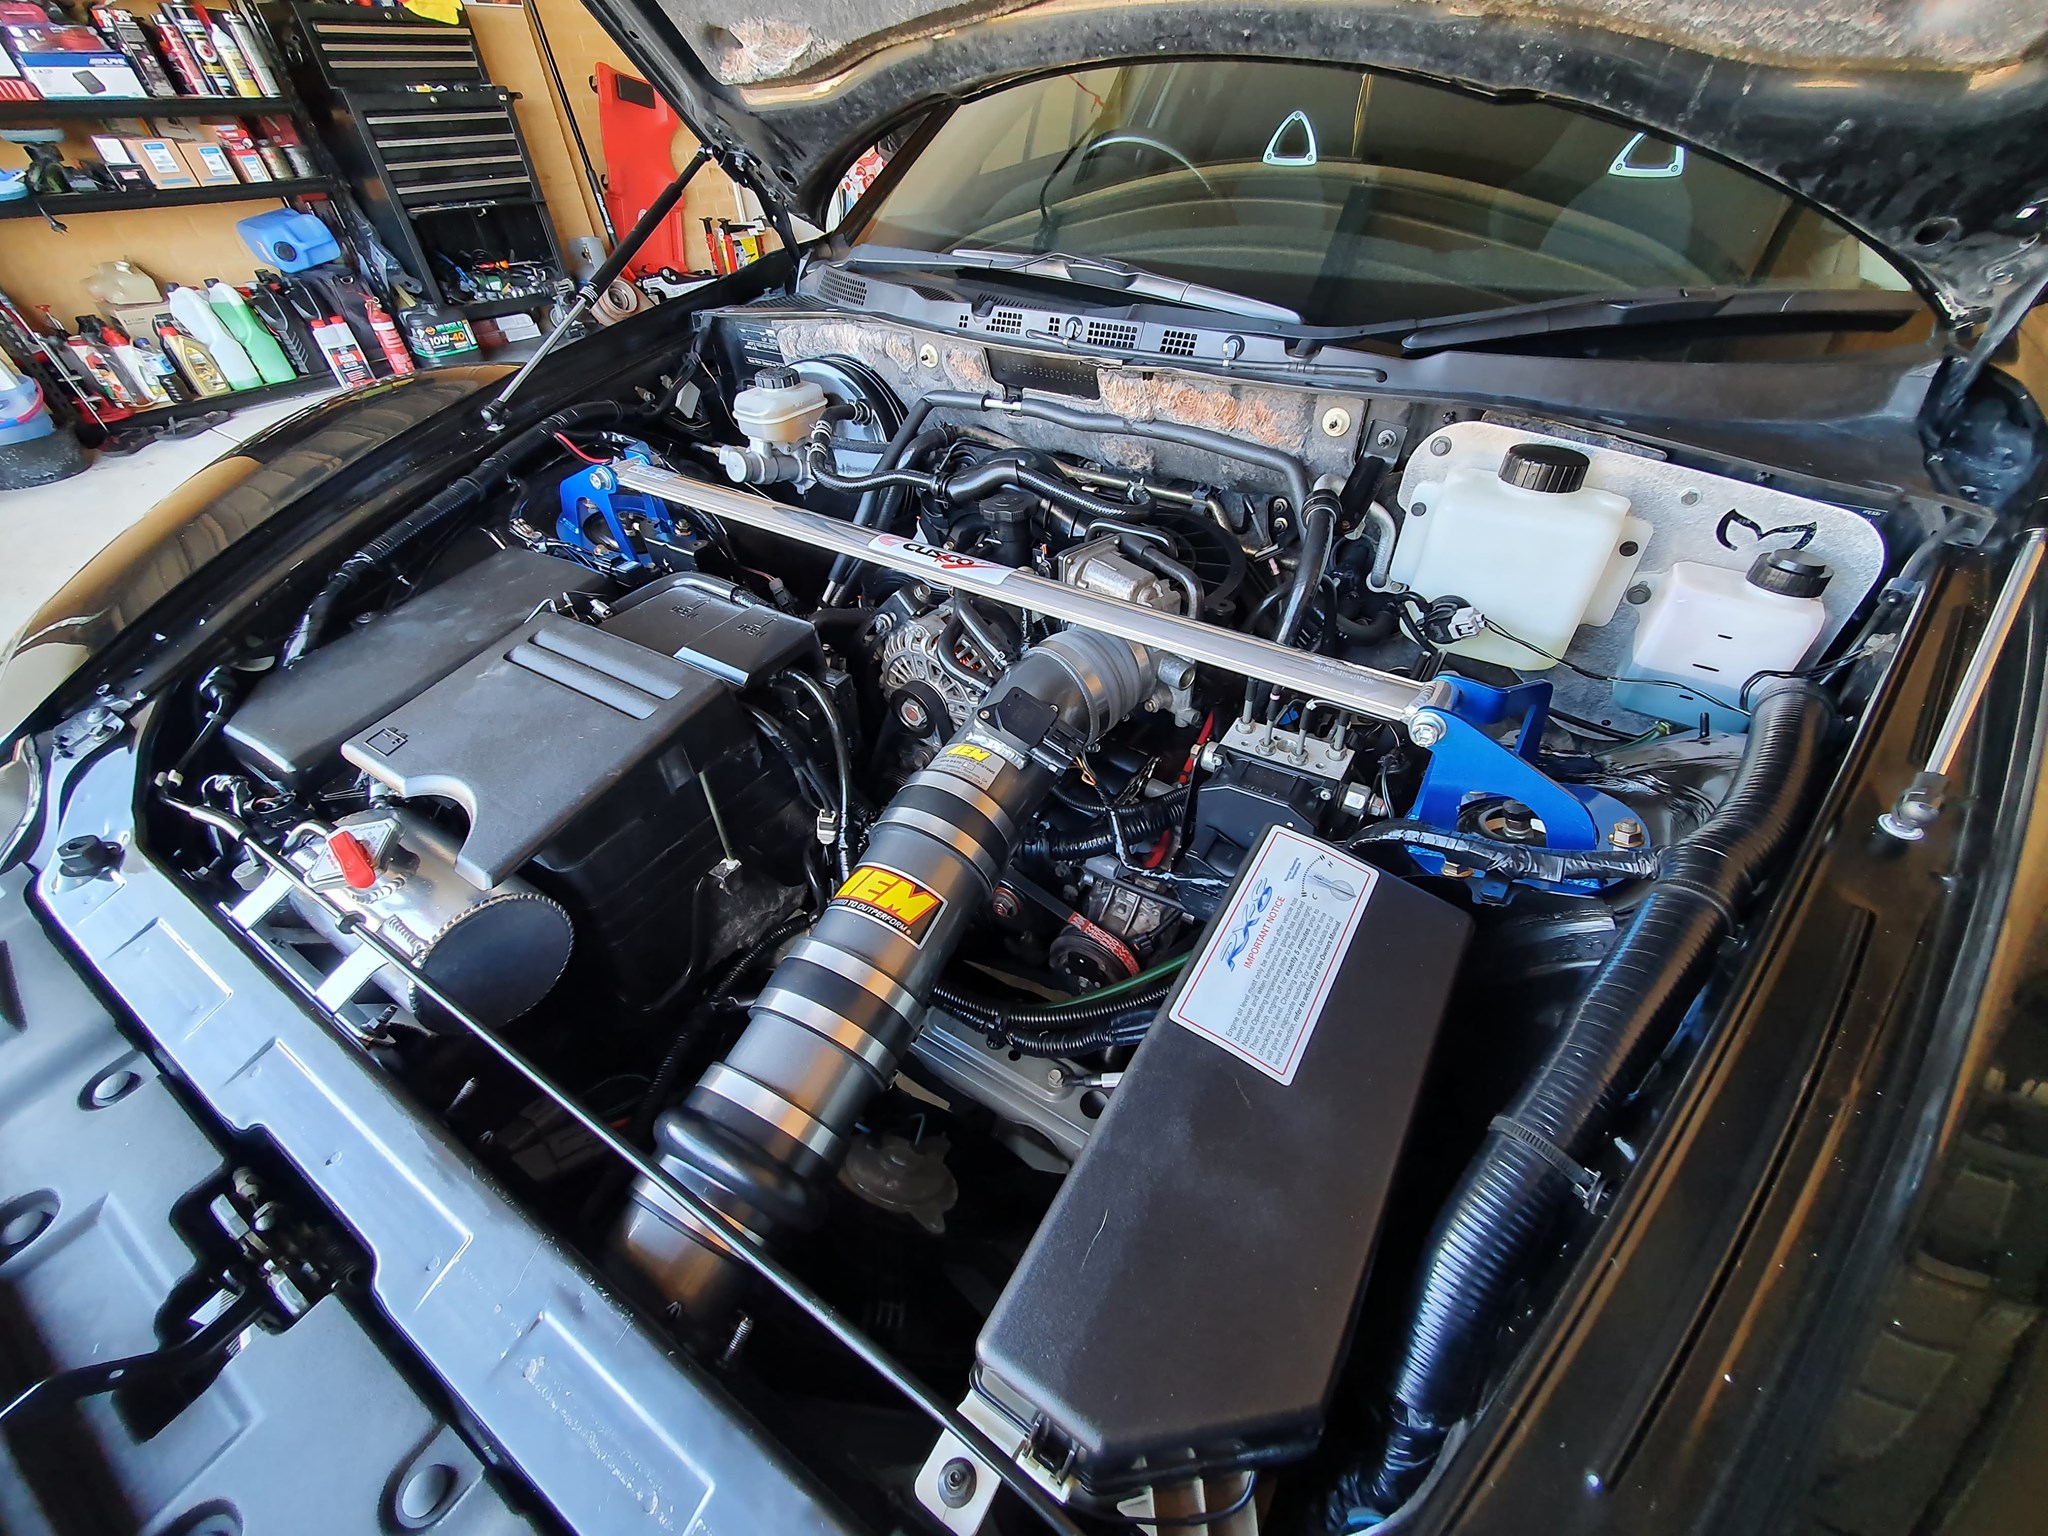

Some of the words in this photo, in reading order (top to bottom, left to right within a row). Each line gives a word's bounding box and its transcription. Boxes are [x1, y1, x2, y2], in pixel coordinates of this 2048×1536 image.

[429, 332, 465, 347] 10W-40
[1327, 860, 1334, 868] H
[834, 867, 939, 924] AEM
[1311, 893, 1319, 901] C
[848, 900, 858, 908] TO
[857, 903, 908, 932] OUTPERFORM
[1218, 876, 1274, 972] RX-8
[1317, 911, 1326, 924] time
[1243, 923, 1271, 969] IMPORTANT
[1265, 895, 1285, 924] NOTICE
[1311, 922, 1321, 937] other
[1307, 937, 1316, 948] any
[1300, 952, 1308, 961] oil
[1314, 959, 1323, 970] the
[1224, 1015, 1241, 1038] Engine
[1235, 1007, 1243, 1016] oil
[1239, 993, 1250, 1008] level
[1246, 978, 1257, 994] must
[1253, 966, 1265, 980] only
[1259, 958, 1267, 967] be
[1263, 935, 1278, 959] checked
[1274, 923, 1285, 936] after
[1280, 905, 1293, 924] vehicle
[1289, 896, 1298, 906] has
[1233, 1025, 1244, 1041] been
[1241, 1006, 1253, 1025] driven
[1250, 994, 1259, 1007] and
[1256, 979, 1267, 995] when
[1263, 946, 1284, 980] temperature
[1280, 930, 1292, 948] gauge
[1287, 920, 1295, 930] has
[1291, 900, 1305, 921] reached
[1292, 960, 1305, 980] engine
[1312, 968, 1319, 976] of
[1248, 1034, 1260, 1050] Then
[1256, 1014, 1269, 1034] switch
[1265, 993, 1280, 1015] engine
[1275, 985, 1283, 994] off
[1279, 975, 1287, 985] for
[1283, 954, 1299, 977] exactly
[1295, 927, 1310, 950] minutes
[1306, 914, 1317, 928] prior
[1264, 1049, 1273, 1060] will
[1269, 1036, 1281, 1051] give
[1276, 1029, 1283, 1038] an
[1301, 969, 1309, 979] For
[1305, 944, 1320, 970] additional
[1316, 928, 1328, 946] details
[1326, 915, 1334, 923] oil
[1301, 979, 1315, 1001] section
[1240, 1024, 1255, 1046] Normal
[1250, 998, 1268, 1026] Operating
[1263, 967, 1283, 1000] temperature
[1286, 940, 1295, 950] the
[1280, 978, 1297, 1006] Checking
[1298, 999, 1306, 1008] to
[1291, 1006, 1303, 1022] refer
[1269, 1019, 1277, 1029] oil
[1256, 1028, 1274, 1056] checking
[1272, 1050, 1283, 1066] level
